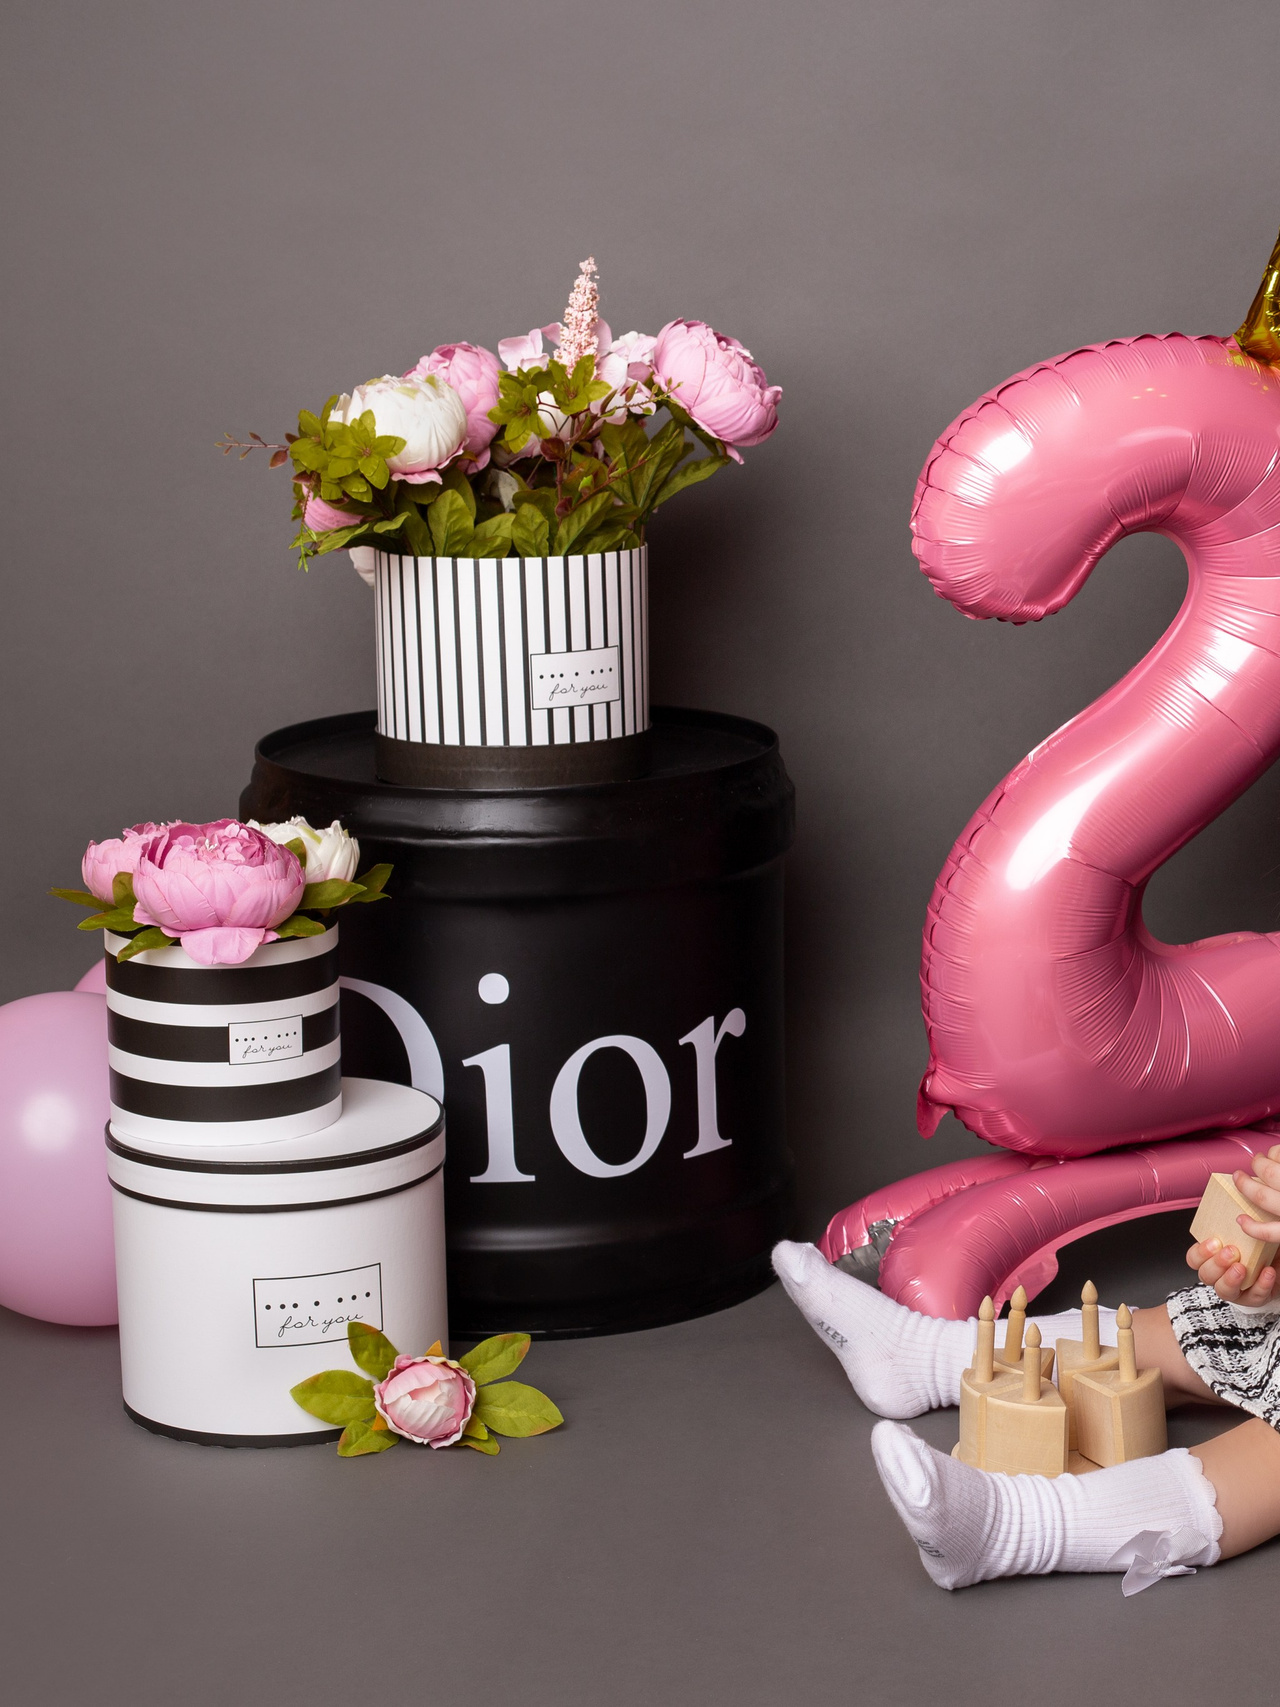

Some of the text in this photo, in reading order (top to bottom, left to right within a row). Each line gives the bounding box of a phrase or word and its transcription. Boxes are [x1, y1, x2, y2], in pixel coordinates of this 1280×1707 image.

[549, 683, 608, 701] for you
[242, 1043, 292, 1058] for you
[278, 1314, 363, 1338] for you
[817, 1320, 848, 1347] ALEX
